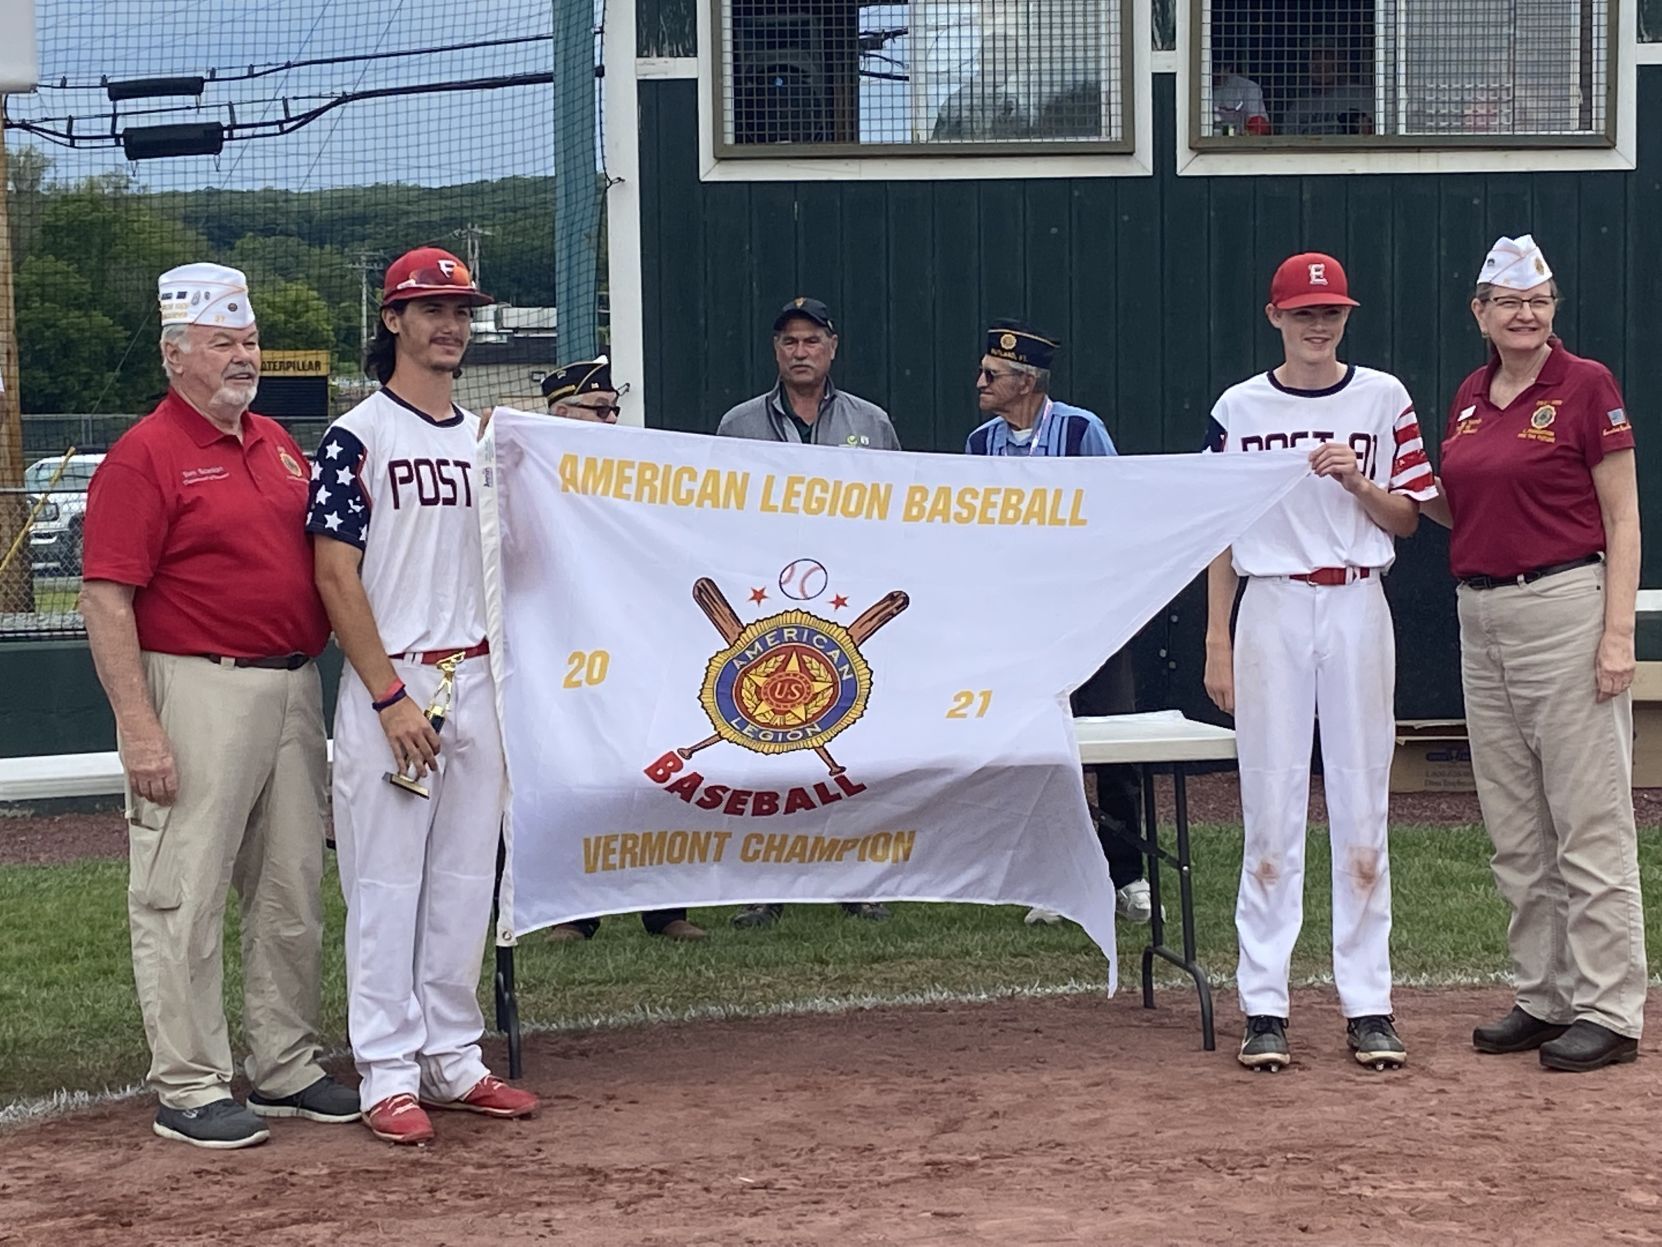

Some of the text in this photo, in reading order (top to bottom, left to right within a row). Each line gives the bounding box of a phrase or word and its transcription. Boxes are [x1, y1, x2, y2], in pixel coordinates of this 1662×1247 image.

[1308, 263, 1328, 286] E
[260, 360, 322, 372] ATERPILLAR
[388, 458, 472, 510] POST
[558, 453, 1088, 527] AMERICAN LEGION BASEBALL
[563, 650, 610, 690] 20
[732, 627, 854, 681] AMERICAN
[773, 681, 803, 701] US
[946, 690, 992, 720] 21
[730, 716, 822, 743] LEGION
[643, 750, 868, 818] BASEBALL
[583, 830, 917, 875] VERMONT CHAMPION
